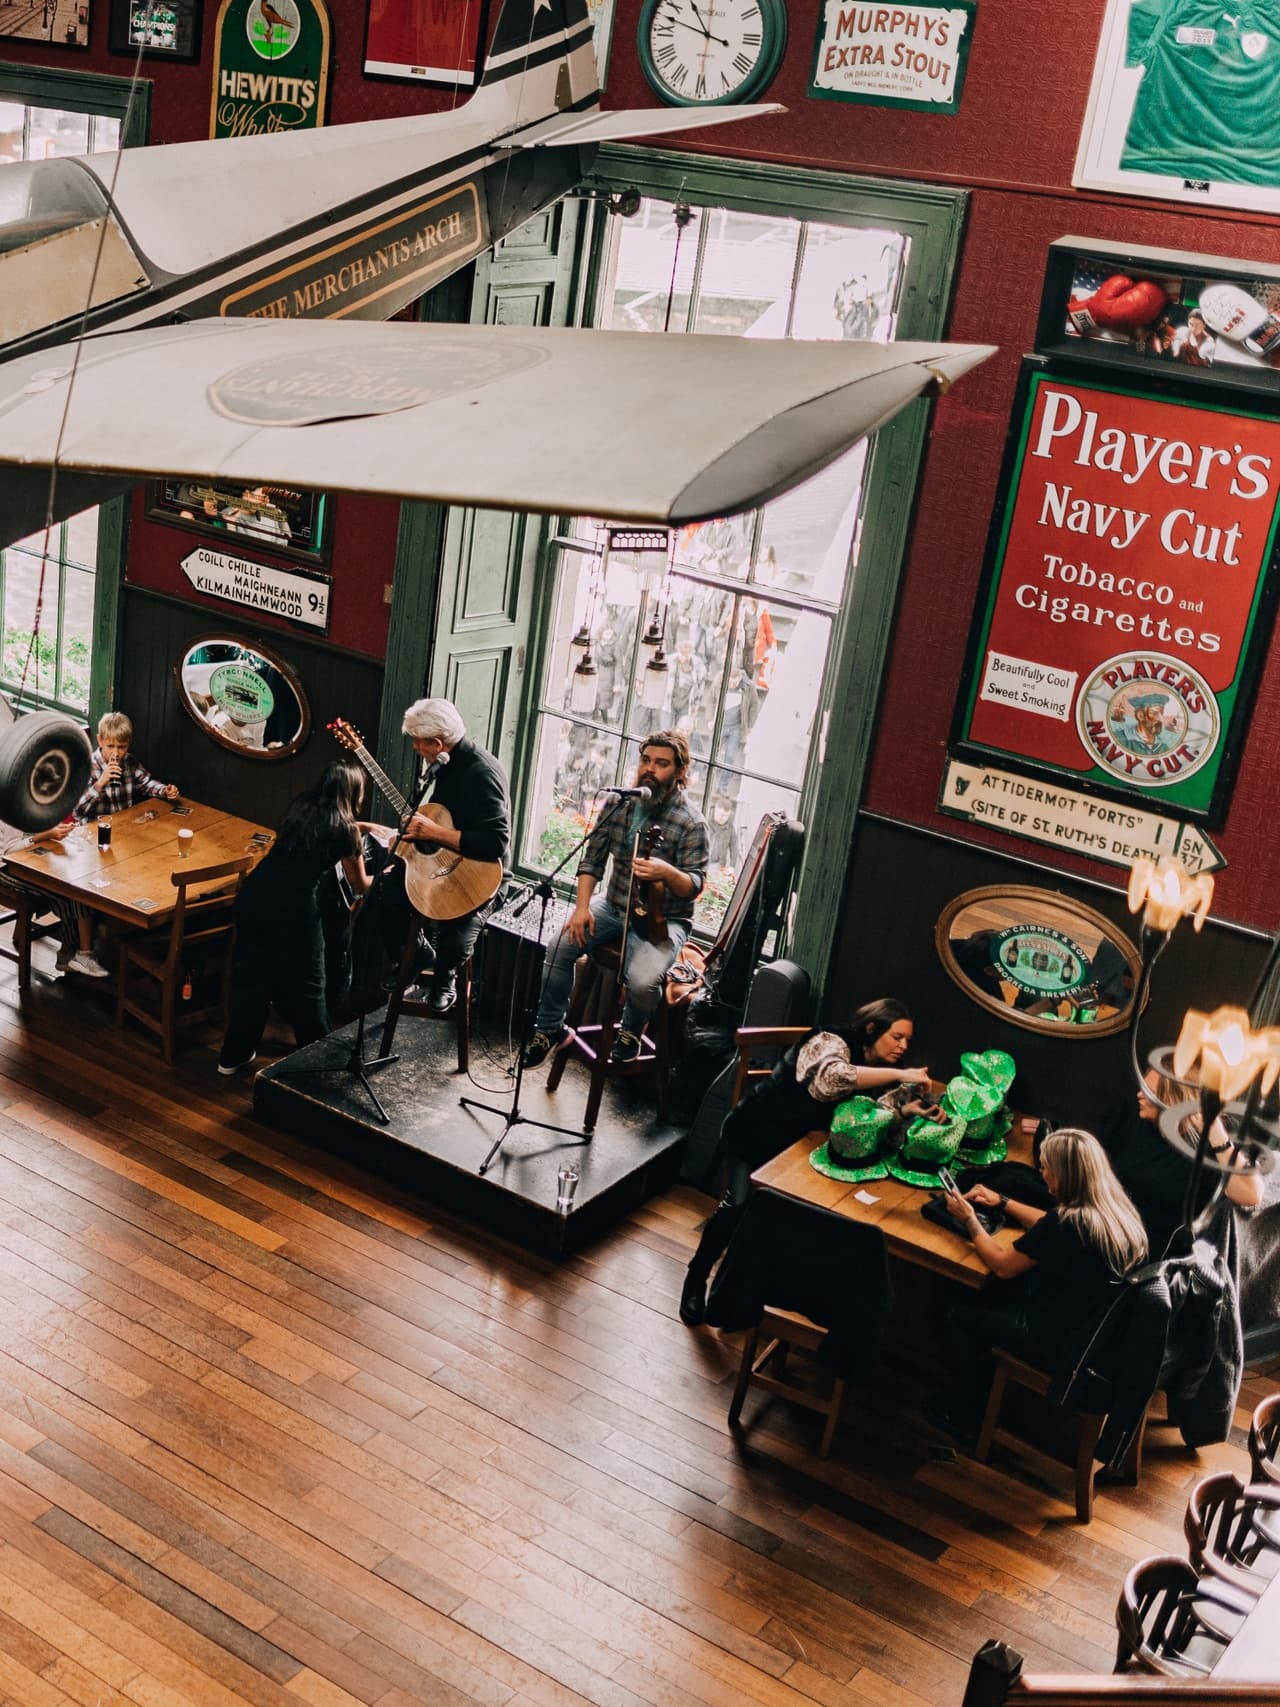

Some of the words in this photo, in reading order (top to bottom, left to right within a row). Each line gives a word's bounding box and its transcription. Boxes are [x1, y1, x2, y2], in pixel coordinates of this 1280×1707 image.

[740, 7, 759, 20] II
[835, 8, 950, 46] MURPHY'S
[657, 24, 675, 37] IX
[742, 34, 761, 46] III
[658, 43, 678, 68] VIII
[732, 52, 753, 75] IIII
[824, 44, 885, 72] EXTRA
[890, 42, 951, 86] STOUT
[220, 69, 316, 109] HEWITTS
[671, 63, 689, 87] VII
[695, 74, 706, 95] VI
[720, 71, 730, 89] V
[855, 70, 883, 80] DRAUGHT
[293, 236, 410, 316] MERCHANTS
[413, 211, 462, 257] ARCH
[1031, 389, 1272, 500] Player's
[1036, 481, 1151, 549] Navy
[1160, 508, 1243, 566] Cut
[198, 551, 224, 568] COILL
[228, 560, 261, 578] CHILLE
[196, 575, 303, 617] KILMAINHAMWOOD
[234, 575, 302, 603] MAIGHNEANN
[1042, 554, 1174, 605] Tobacco
[1179, 598, 1204, 613] and
[1015, 583, 1222, 653] Cigarettes
[991, 657, 1046, 686] Beautifully
[1046, 672, 1070, 688] Cool
[1102, 660, 1207, 714] PLAYER'S
[987, 682, 1020, 701] Sweet
[1020, 691, 1067, 716] Smoking
[1086, 719, 1143, 774] NAVY
[971, 799, 1006, 820] (SITE
[1010, 811, 1028, 825] OF
[1054, 823, 1107, 850] RUTH'S
[1180, 852, 1204, 871] 371
[1182, 838, 1204, 856] SN
[1013, 925, 1059, 938] CAIRNES
[993, 962, 1037, 995] DROGHEDA
